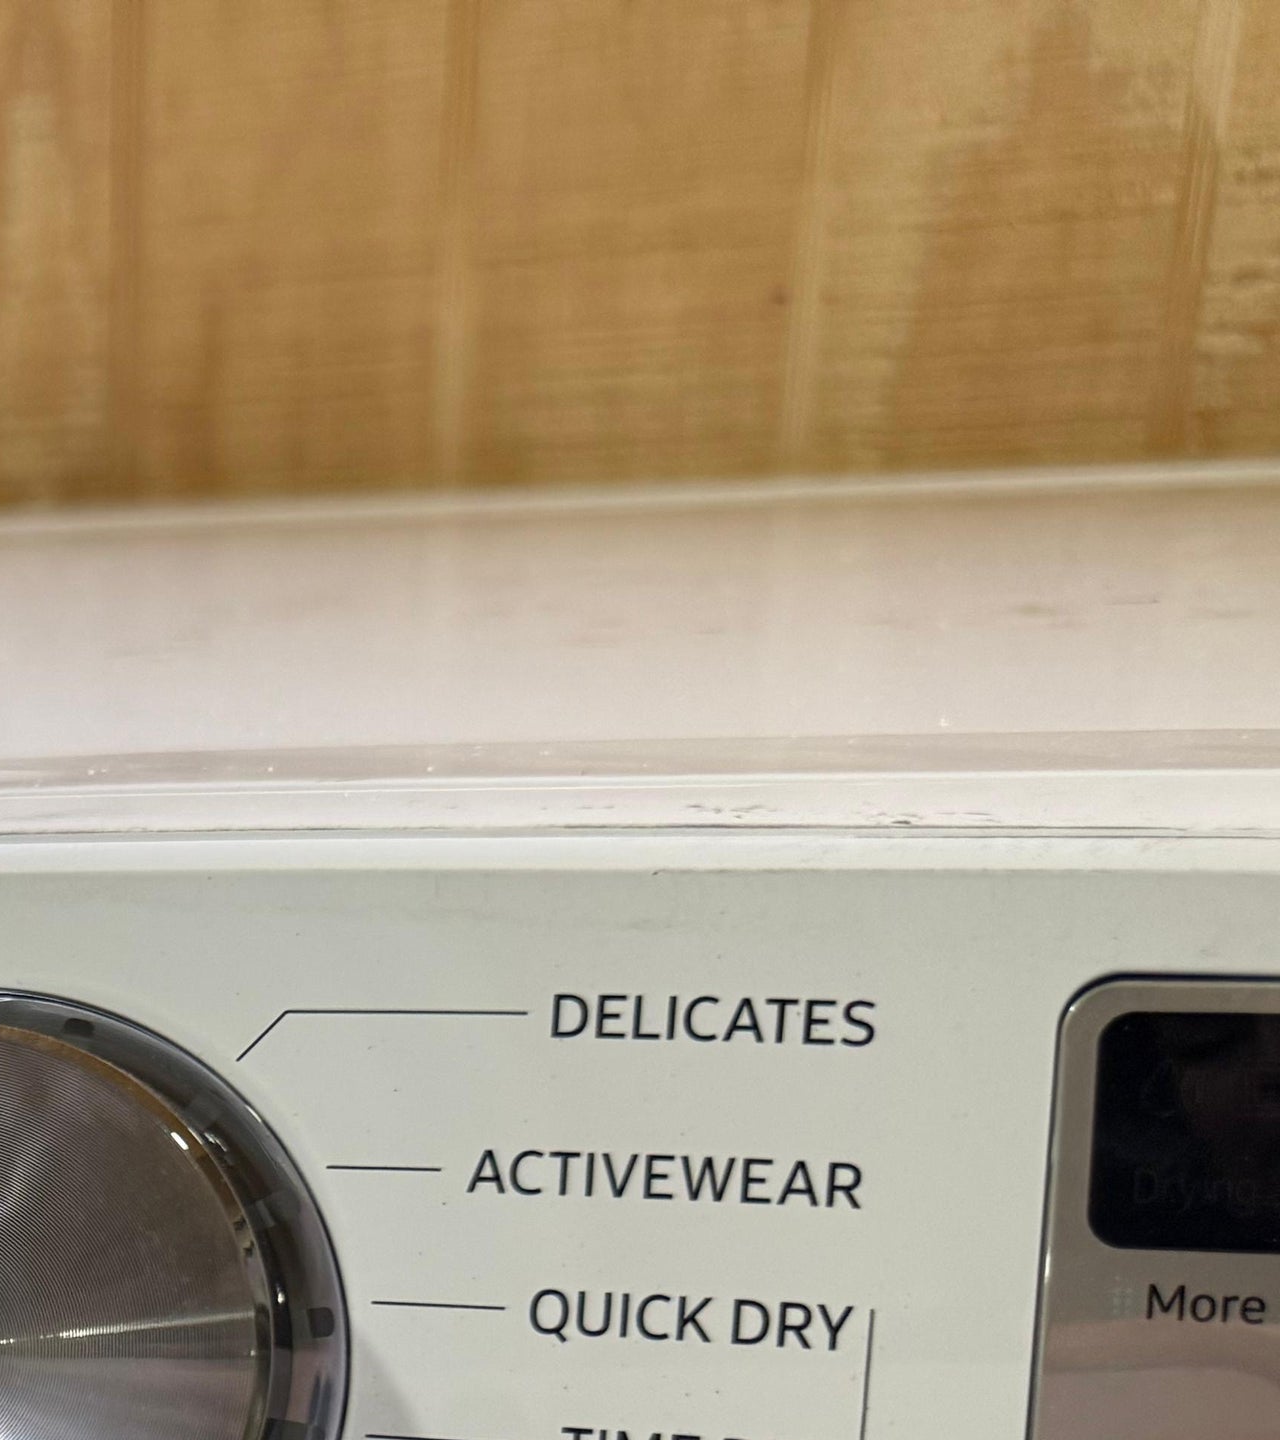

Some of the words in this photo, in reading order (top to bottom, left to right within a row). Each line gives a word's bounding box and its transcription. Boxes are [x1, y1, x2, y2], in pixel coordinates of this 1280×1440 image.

[550, 993, 877, 1048] DELICATES
[466, 1148, 863, 1210] ACTIVEWEAR
[529, 1288, 713, 1344] QUICK
[730, 1298, 855, 1352] DRY
[1145, 1282, 1267, 1325] More
